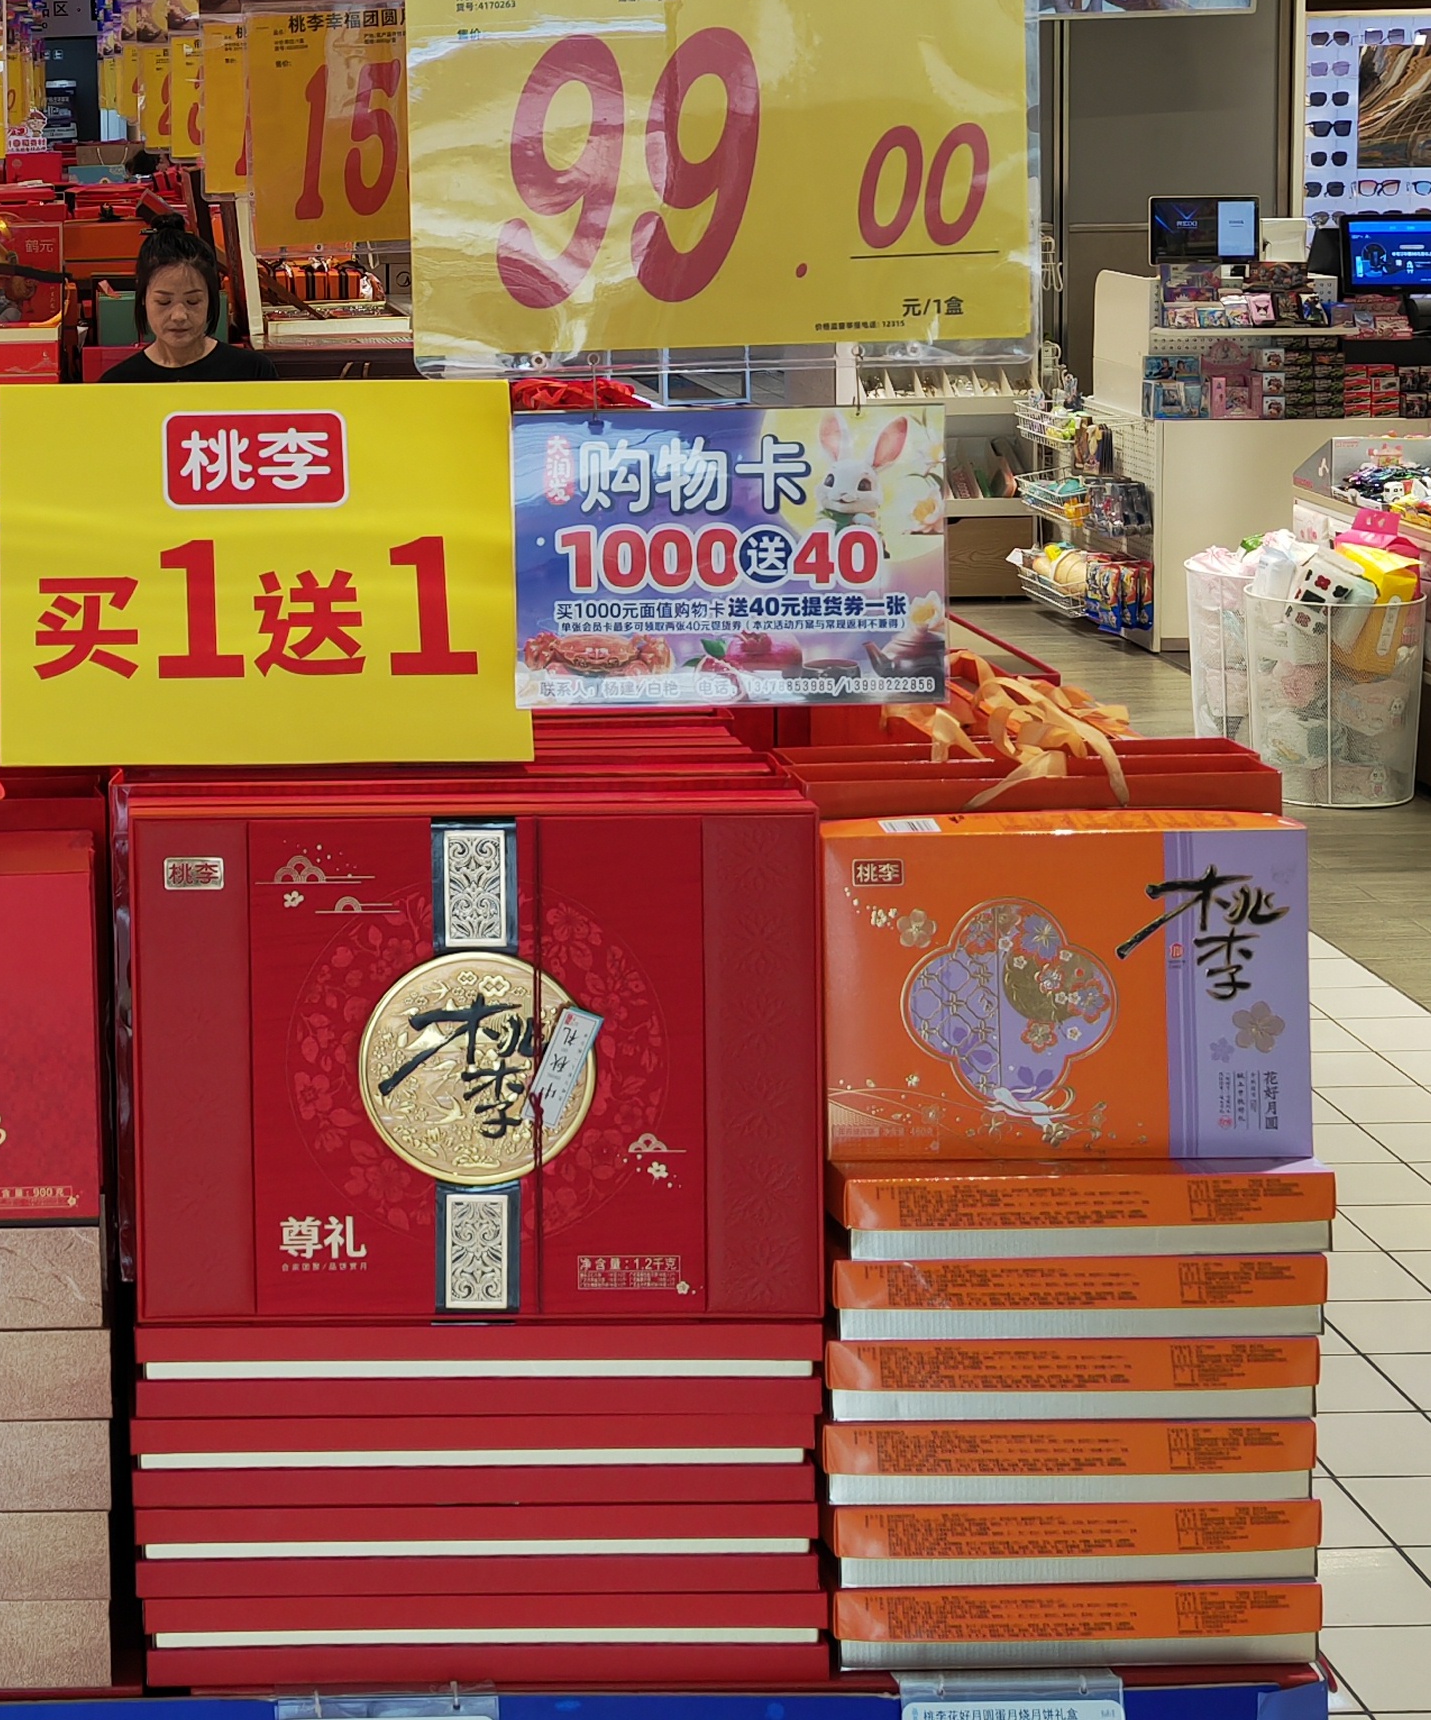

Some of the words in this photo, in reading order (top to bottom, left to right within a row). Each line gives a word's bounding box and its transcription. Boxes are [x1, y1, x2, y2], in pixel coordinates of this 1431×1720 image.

[455, 0, 517, 13] 货号:4170263
[901, 295, 965, 318] 元/1盒
[180, 425, 332, 493] 桃李
[580, 434, 808, 513] 购物卡
[32, 536, 479, 680] 买1送1
[554, 599, 727, 620] 买1000元面值购物卡
[728, 594, 907, 617] 送40元提货券一张
[167, 862, 220, 887] 桃李
[855, 861, 901, 885] 桃李
[279, 1214, 368, 1259] 尊礼
